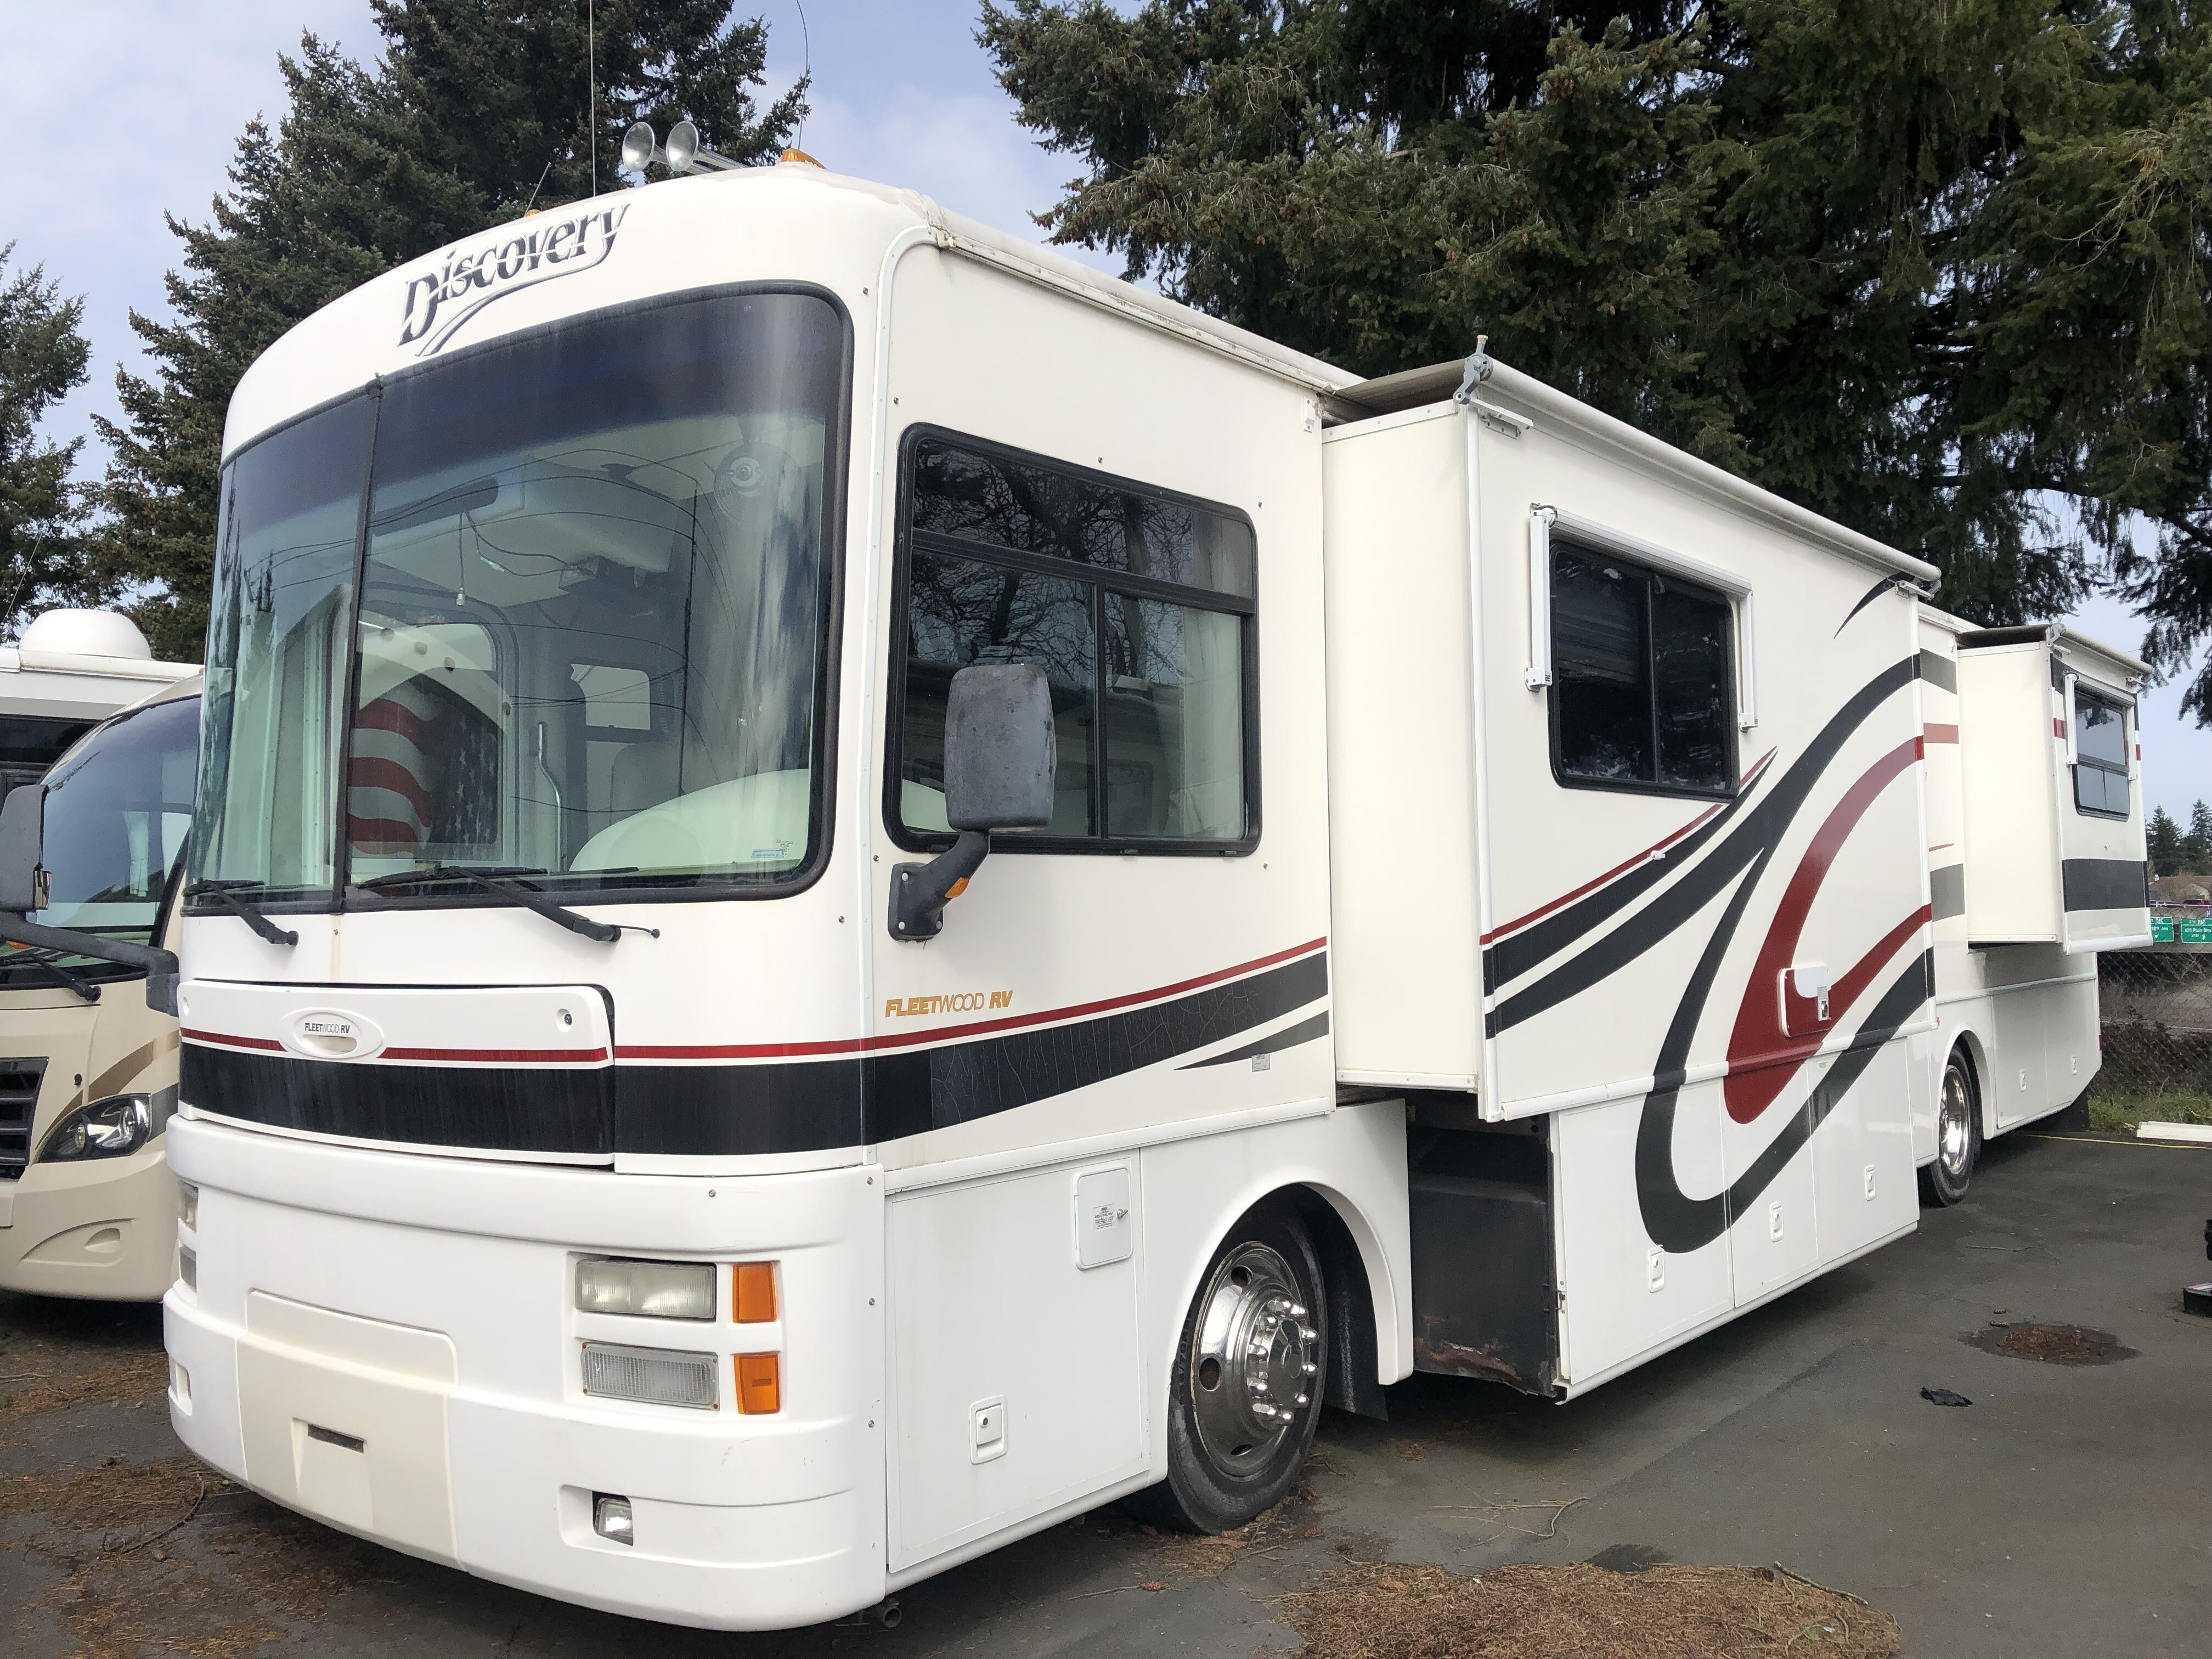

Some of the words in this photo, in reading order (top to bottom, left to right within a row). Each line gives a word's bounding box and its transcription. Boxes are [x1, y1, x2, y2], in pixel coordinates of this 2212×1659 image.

[397, 204, 631, 347] Discovery
[885, 992, 985, 1018] FLEETWOOD
[989, 990, 1014, 1009] RV
[304, 1023, 340, 1034] FLEETWOOD
[340, 1024, 351, 1034] RV
